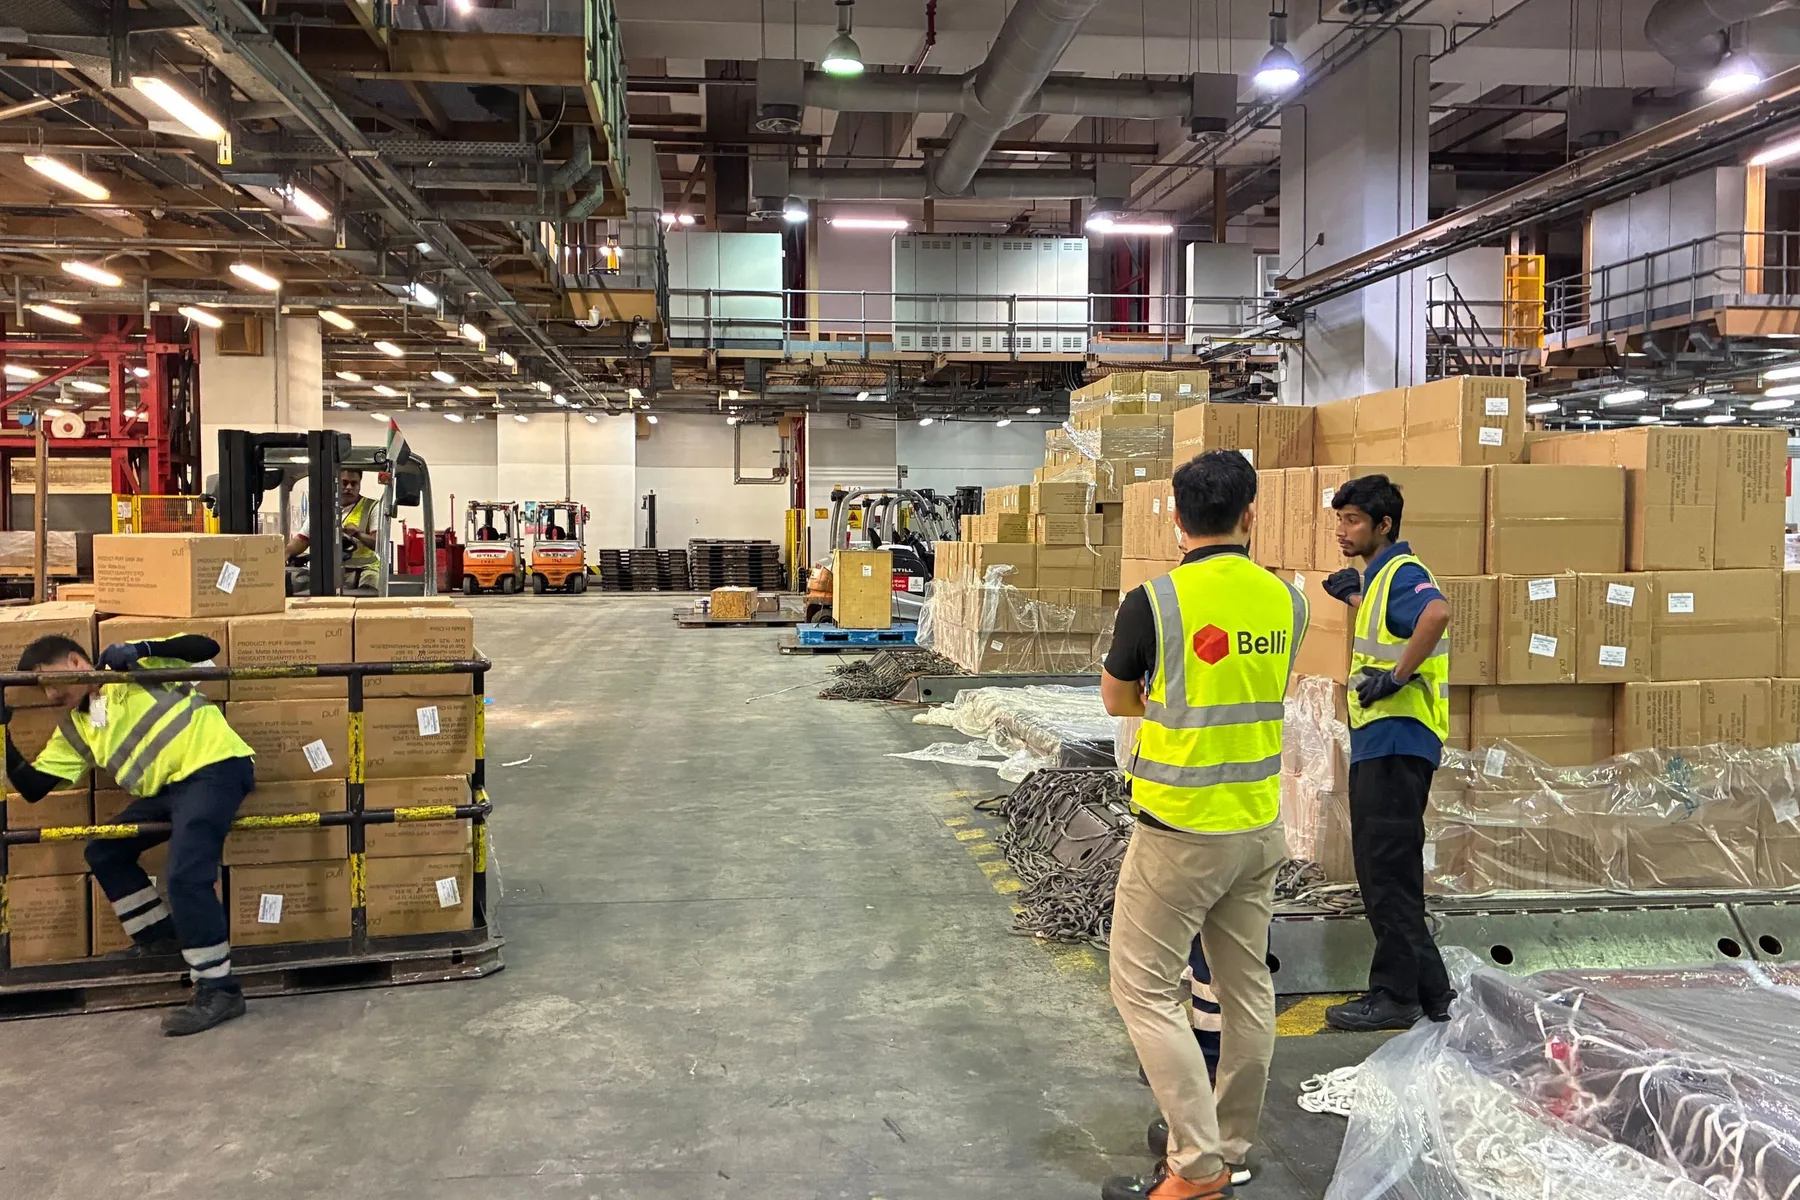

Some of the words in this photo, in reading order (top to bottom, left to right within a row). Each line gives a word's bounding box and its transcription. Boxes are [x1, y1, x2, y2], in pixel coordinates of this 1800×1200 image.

[172, 548, 184, 556] puff
[265, 545, 279, 556] puff
[1698, 546, 1706, 562] puff
[325, 628, 342, 639] puff
[1237, 630, 1286, 655] Belli
[1479, 661, 1488, 677] puff
[364, 677, 382, 688] puff
[322, 708, 340, 718] puff
[367, 758, 384, 768] puff
[326, 869, 344, 879] puff
